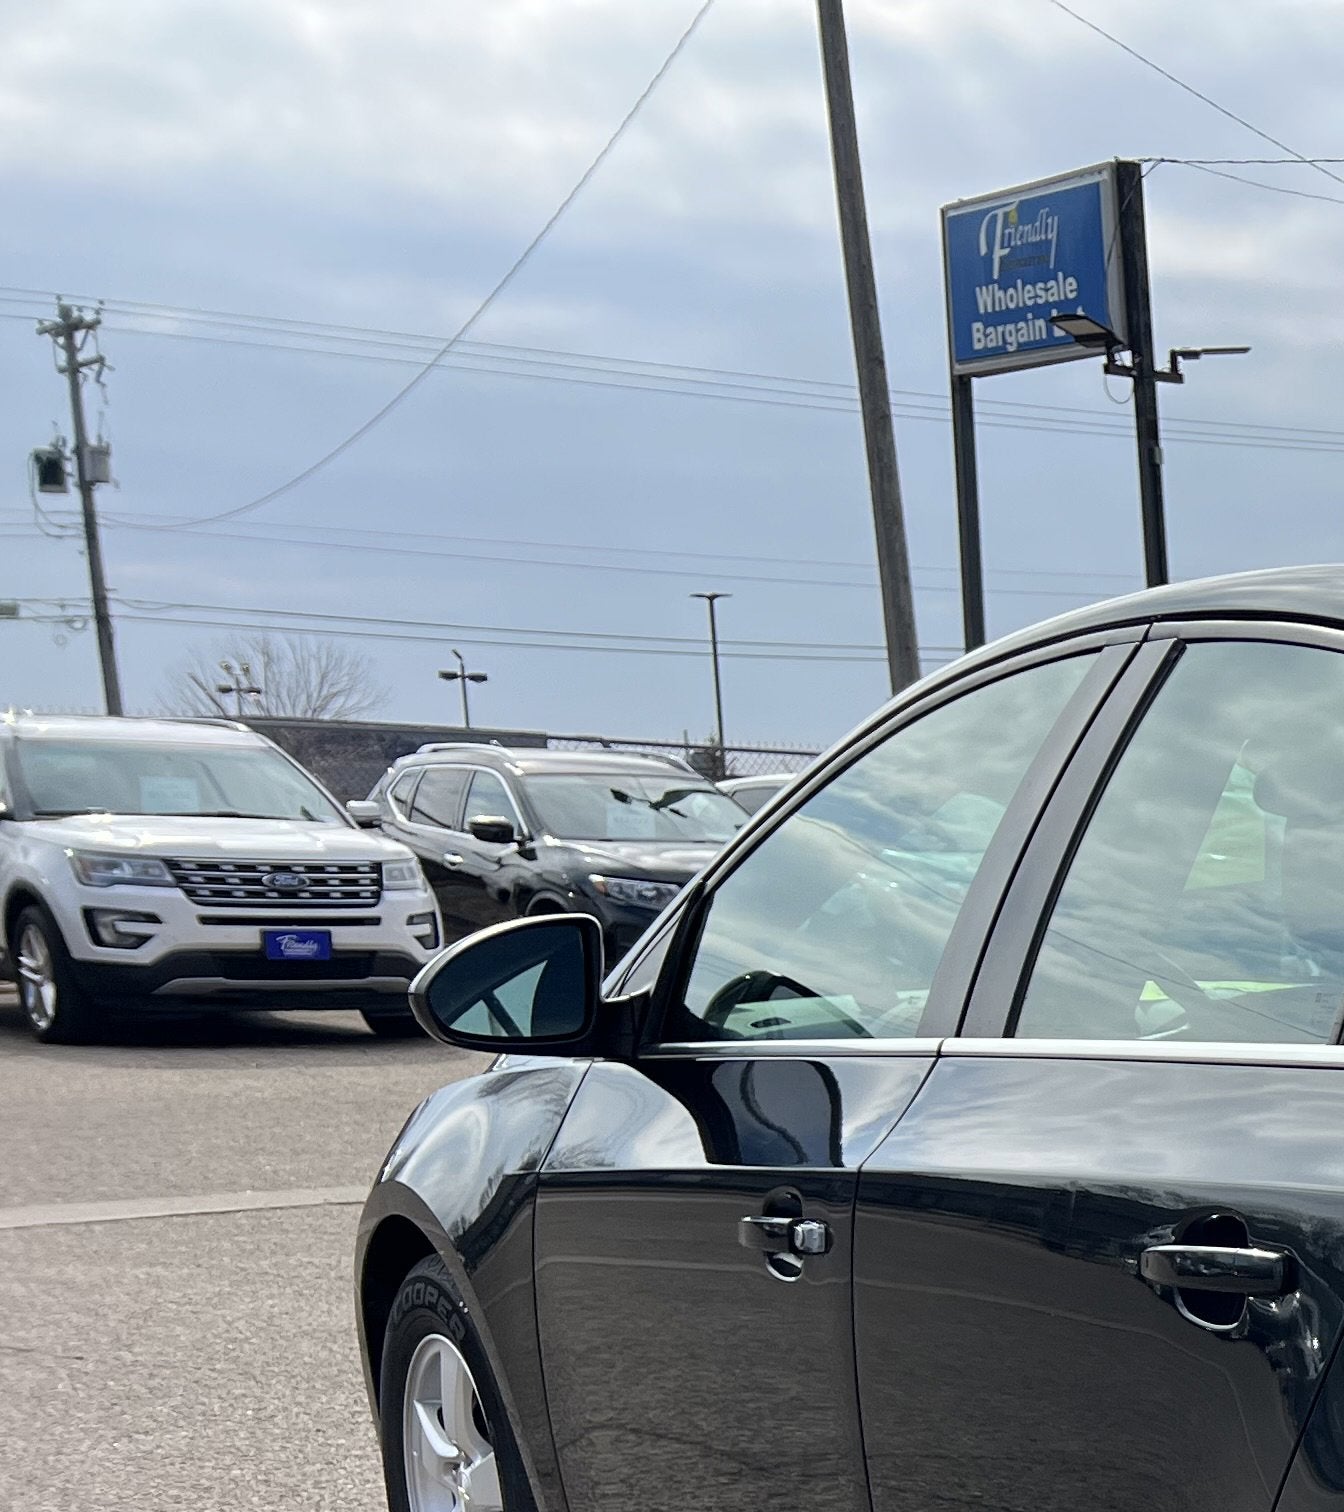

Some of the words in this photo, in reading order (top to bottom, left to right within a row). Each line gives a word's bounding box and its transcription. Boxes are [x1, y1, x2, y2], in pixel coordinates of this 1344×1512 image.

[979, 201, 1058, 279] Friendly
[976, 272, 1078, 314] Wholesale
[972, 311, 1047, 351] Bargain
